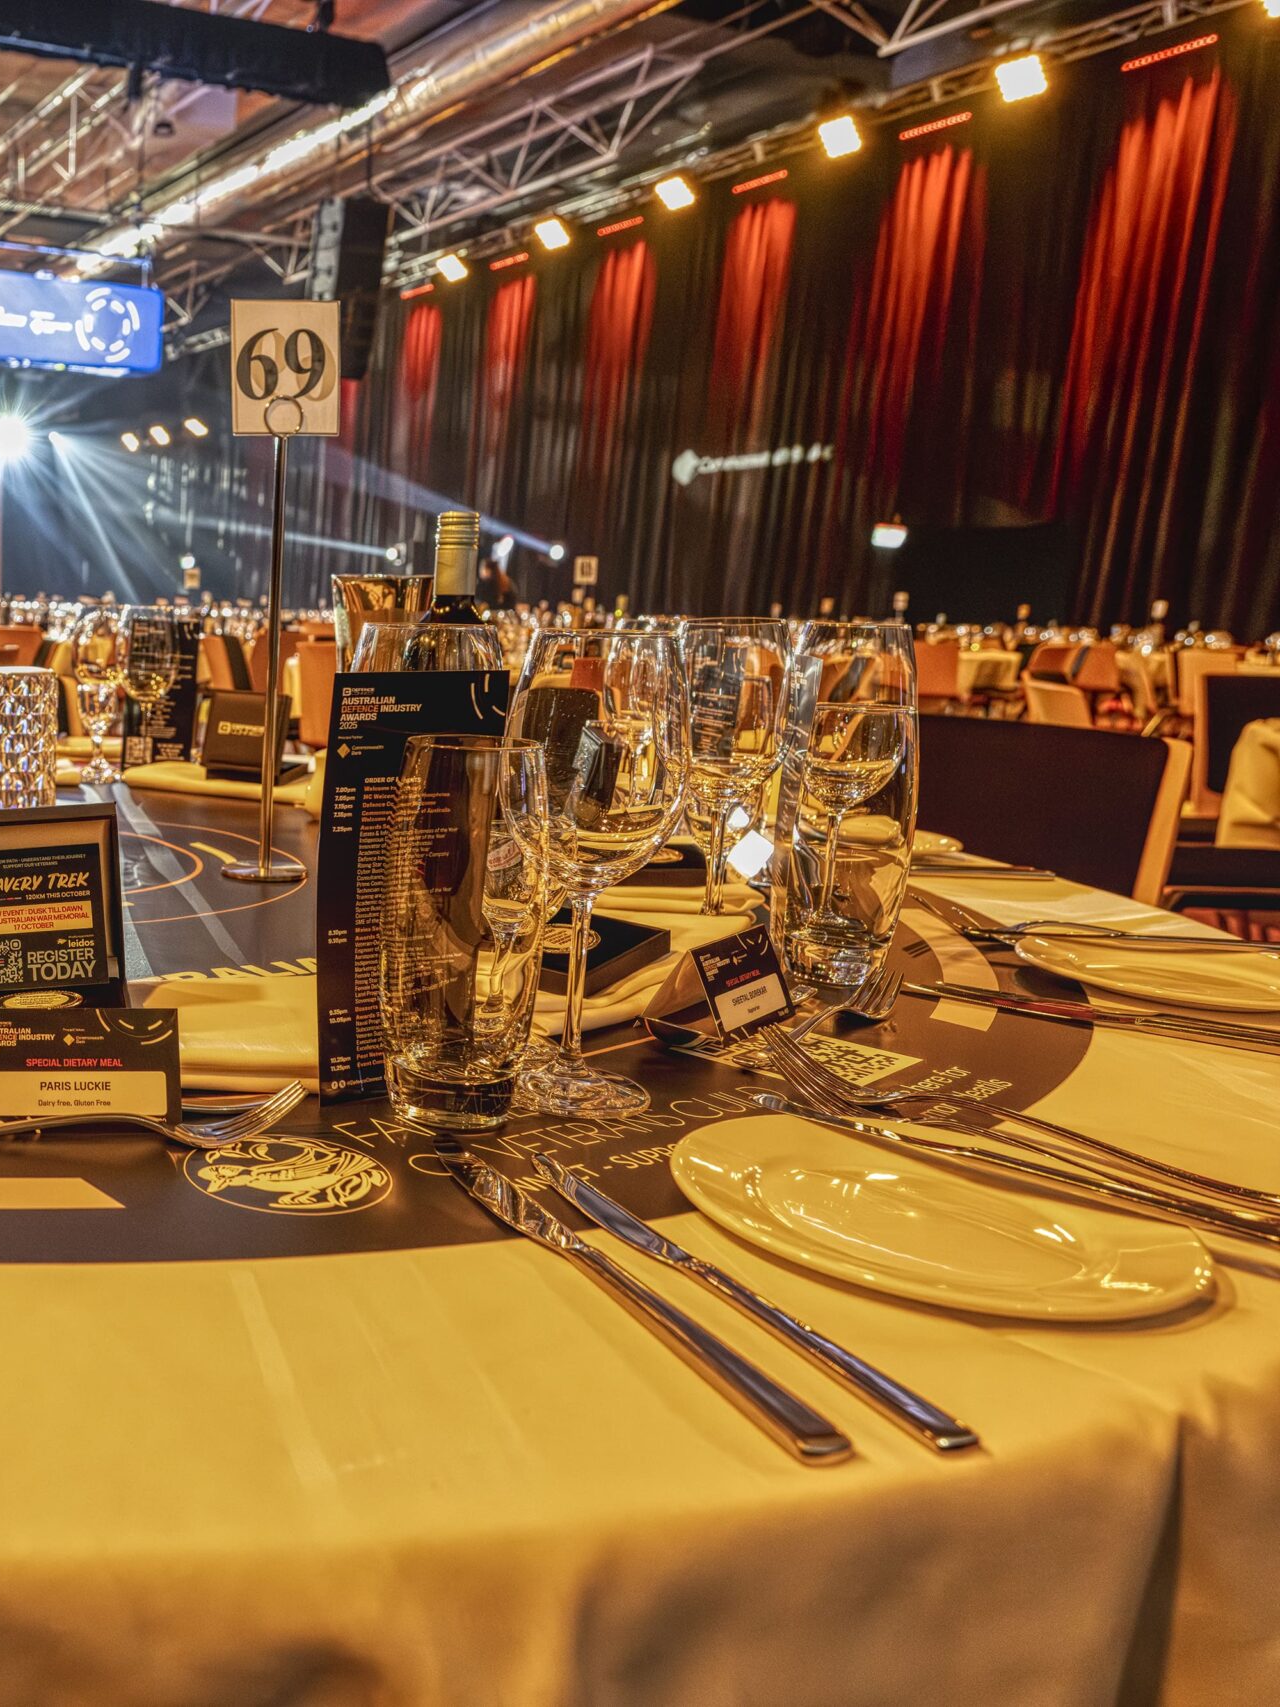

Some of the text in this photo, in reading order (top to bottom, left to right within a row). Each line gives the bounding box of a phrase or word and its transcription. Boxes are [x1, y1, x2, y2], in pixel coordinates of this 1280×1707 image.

[236, 327, 326, 400] 69
[341, 696, 396, 705] AUSTRALIAN
[341, 703, 423, 713] DEFENCE INDUSTRY
[340, 713, 378, 721] AWARDS
[339, 721, 358, 730] 2025
[47, 871, 90, 890] TREK
[61, 890, 91, 898] OCTOBER
[2, 909, 24, 917] EVENT
[28, 907, 47, 915] DUSK
[47, 906, 62, 914] TILL
[61, 905, 83, 913] DAWN
[53, 912, 90, 920] MEMORIAL
[21, 922, 54, 930] OCTOBER
[68, 938, 95, 948] leidos
[27, 948, 95, 964] REGISTER
[27, 960, 96, 982] TODAY
[18, 1033, 56, 1041] INDUSTRY
[26, 1058, 123, 1067] SPECIAL DIETARY MEAL
[900, 1066, 972, 1092] here for
[40, 1081, 111, 1091] PARIS LUCKIE
[38, 1099, 56, 1108] Dairy
[56, 1099, 73, 1108] free,
[96, 1099, 111, 1107] Free
[471, 1111, 685, 1161] VETERANS
